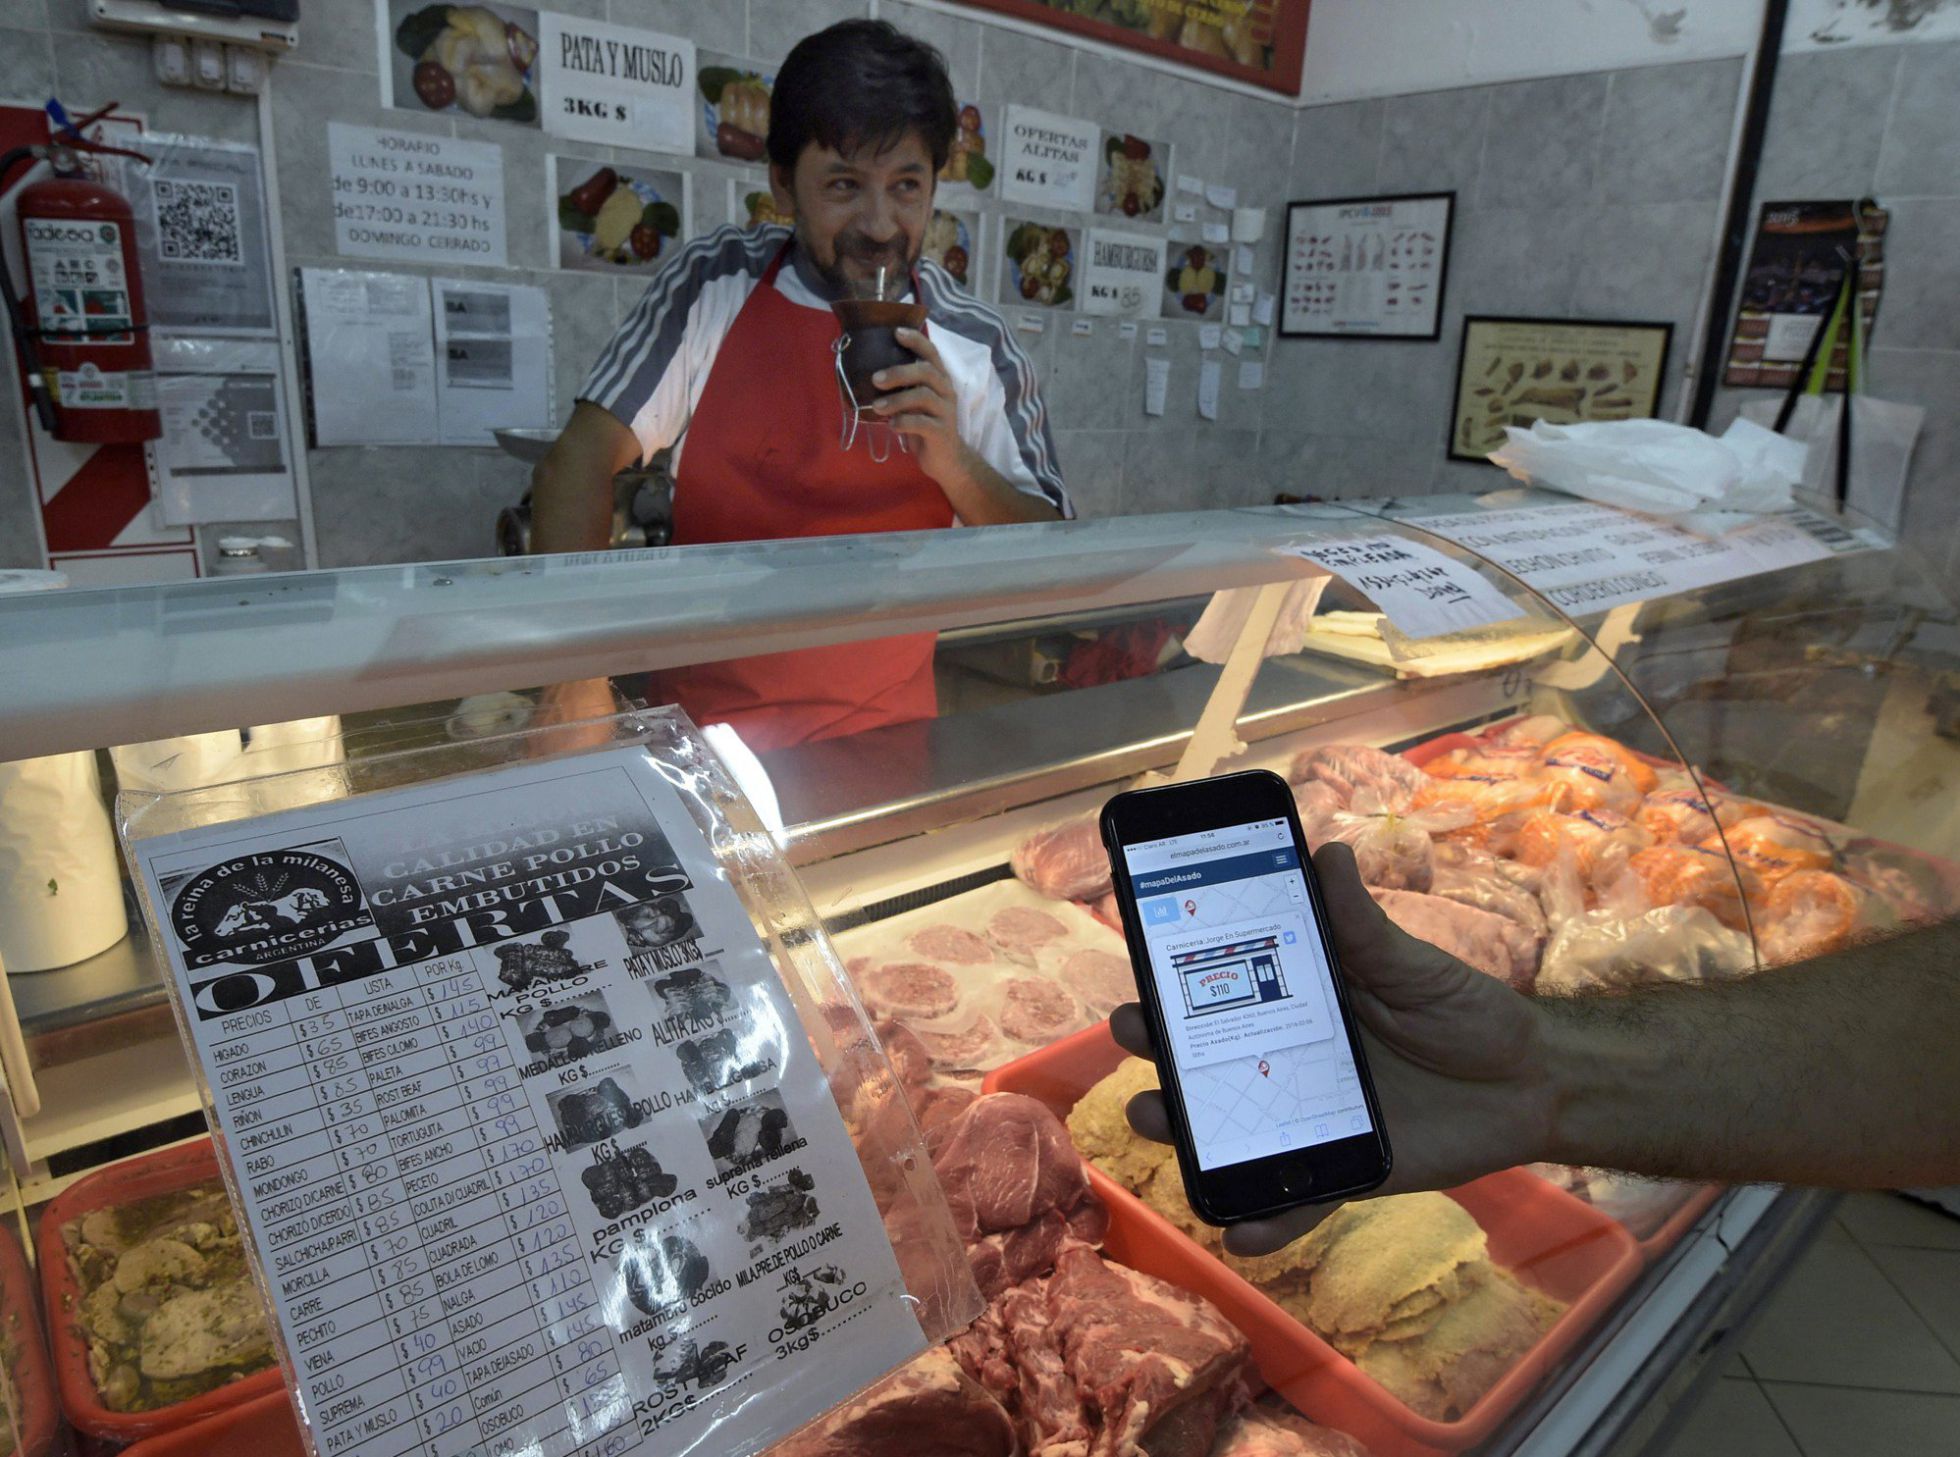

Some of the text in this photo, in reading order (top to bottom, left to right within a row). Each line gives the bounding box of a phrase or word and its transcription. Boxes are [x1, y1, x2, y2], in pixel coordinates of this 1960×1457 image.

[561, 33, 683, 88] PATA Y MUSLO
[564, 97, 608, 118] 3KG
[378, 137, 440, 155] HORARIO
[1014, 124, 1088, 149] OFERTAS
[1022, 142, 1080, 163] ALITAS
[352, 154, 474, 180] LUNES A SABADO
[332, 174, 352, 192] de
[357, 177, 396, 196] 9:00
[400, 186, 410, 198] a
[407, 213, 417, 225] a
[422, 211, 468, 230] 21:30
[472, 215, 490, 232] hs
[350, 229, 491, 253] DOMINGO CERRADO
[383, 815, 620, 879] CALIDAD EN
[1170, 839, 1250, 860] elmapadelasado.com.ar
[371, 832, 644, 907] CARNE POLLO
[1139, 872, 1202, 890] #mapaDelAsado
[182, 856, 354, 942] la reina de la milanesa
[408, 855, 641, 926] EMBUTIDOS
[195, 914, 372, 964] carnicerias
[196, 864, 689, 1012] OFERTAS
[1204, 936, 1224, 946] Jorge
[1224, 932, 1234, 940] En
[1235, 924, 1281, 938] Supermercado
[256, 938, 326, 962] ARGENTINA
[623, 953, 648, 980] PATA
[652, 943, 682, 972] MUSLO
[516, 976, 588, 1004] POLLO
[1200, 970, 1238, 988] PRECIO
[1210, 983, 1230, 998] $110
[222, 1010, 272, 1034] PRECIOS
[305, 996, 322, 1012] DE
[364, 978, 394, 995] LISTA
[424, 963, 446, 978] POR
[348, 1010, 372, 1024] TAPA
[500, 1004, 534, 1020] KG
[354, 1015, 420, 1044] BIFES ANGOSTO
[652, 1012, 690, 1048] ALITA
[213, 1044, 249, 1062] HIGADO
[362, 1047, 386, 1064] BIFES
[220, 1060, 268, 1084] CORAZON
[369, 1064, 404, 1084] PALETA
[558, 1069, 578, 1086] KG
[226, 1085, 265, 1106] LENGUA
[376, 1080, 422, 1106] ROST BEAF
[633, 1091, 672, 1116] POLLO
[233, 1108, 262, 1128] RIÑON
[383, 1104, 428, 1128] PALOMITA
[240, 1123, 294, 1150] CHINCHULIN
[391, 1122, 445, 1150] TORTUGUITA
[246, 1155, 275, 1174] RABO
[398, 1154, 424, 1172] BIFES
[424, 1142, 454, 1164] ANCHO
[592, 1142, 612, 1164] KG
[706, 1138, 808, 1190] suprema rellena
[253, 1168, 308, 1198] MONDONGO
[406, 1172, 439, 1194] PECETO
[727, 1180, 750, 1200] KG
[260, 1196, 302, 1222] CHORIZO
[414, 1196, 446, 1218] COLITA
[592, 1189, 698, 1246] pamplona
[268, 1220, 310, 1246] CHORIZO
[422, 1217, 458, 1240] CUADRIL
[429, 1235, 478, 1264] CUADRADA
[590, 1238, 625, 1264] KG
[784, 1222, 842, 1264] POLLO O CARNE
[281, 1268, 330, 1296] MORCILLA
[435, 1252, 499, 1288] BOLA DE LOMO
[442, 1288, 476, 1312] NALGA
[690, 1279, 732, 1308] cocido
[290, 1297, 324, 1321] CARRE
[768, 1282, 867, 1344] OSOBUCO
[296, 1320, 336, 1347] PECHITO
[452, 1312, 484, 1336] ASADO
[304, 1350, 336, 1372] VIENA
[458, 1338, 488, 1360] VACIO
[312, 1374, 345, 1400] POLLO
[466, 1364, 492, 1385] TAPA
[320, 1394, 366, 1426] SUPREMA
[474, 1388, 504, 1410] Común
[326, 1428, 354, 1452] PATA
[354, 1422, 364, 1438] Y
[364, 1408, 398, 1433] MUSLO
[481, 1404, 524, 1435] OSOBUCO
